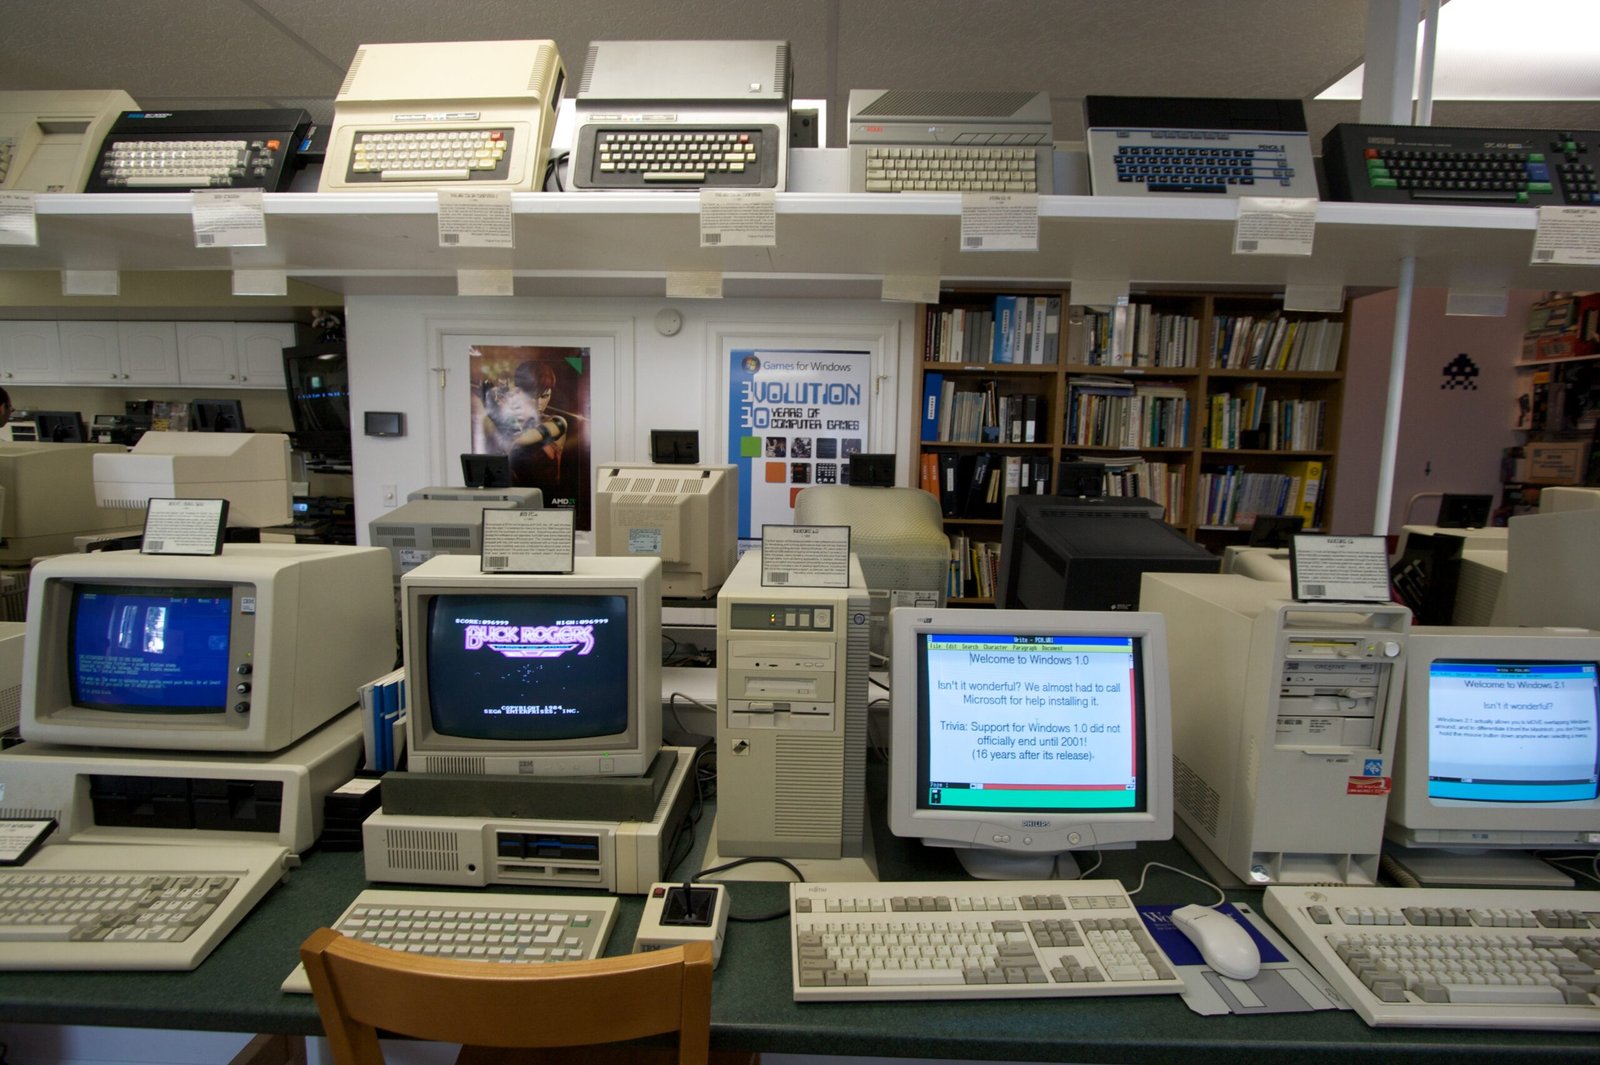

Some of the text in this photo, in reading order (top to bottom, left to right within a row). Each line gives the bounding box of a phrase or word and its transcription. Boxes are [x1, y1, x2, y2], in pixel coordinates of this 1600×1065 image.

[763, 361, 852, 372] Games for Windows
[741, 406, 770, 429] 30
[771, 408, 821, 418] YEARS OF
[771, 419, 860, 430] COMPUTER GAMES
[464, 625, 595, 655] BUCK ROGERS
[971, 653, 1089, 665] Welcome to Windows 1.0
[937, 680, 1120, 693] Isn't it wonderful? We almost had to call
[1464, 680, 1565, 689] Welcome to Windows 2.1
[963, 694, 1099, 708] Microsoft for help installing it.
[1483, 701, 1553, 711] Isn't it wonderful?
[940, 721, 1120, 734] Trivia: Support for Windows 1.0 did not
[977, 736, 1087, 748] officially end until 2001!
[972, 749, 987, 760] (16
[990, 750, 1016, 761] years
[1019, 750, 1039, 760] after
[1042, 750, 1053, 760] its
[1023, 820, 1050, 828] PHILIPS
